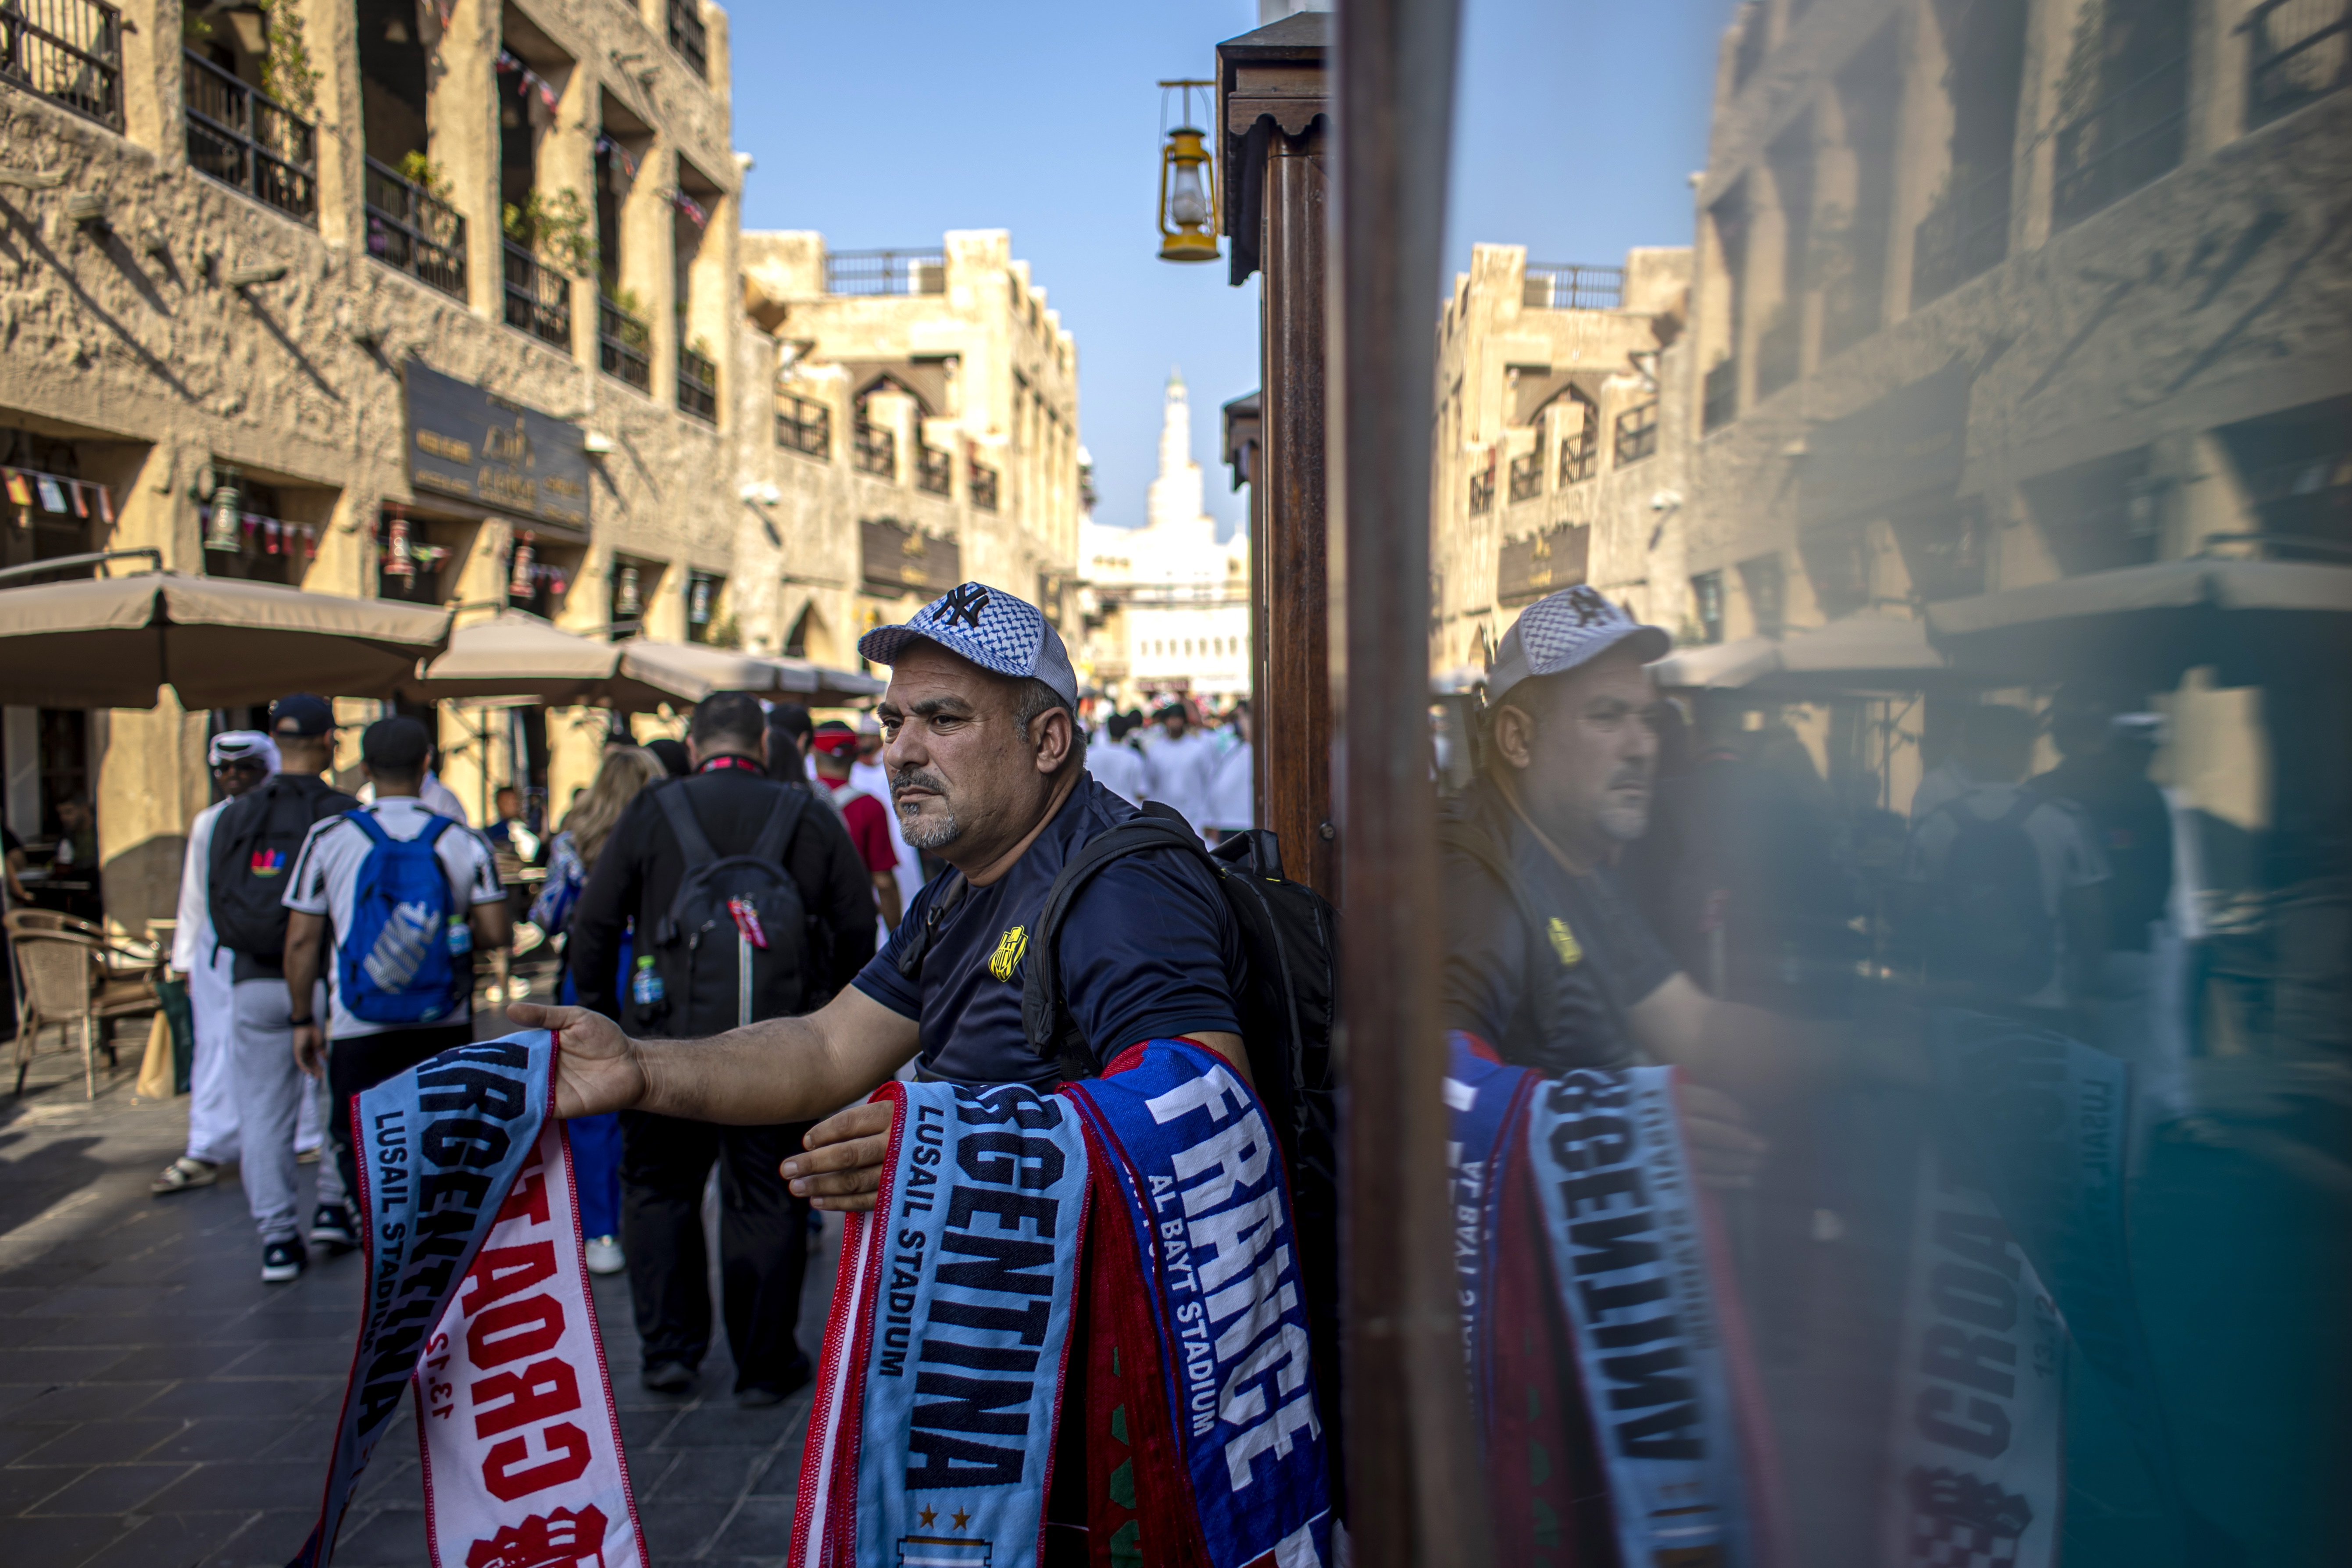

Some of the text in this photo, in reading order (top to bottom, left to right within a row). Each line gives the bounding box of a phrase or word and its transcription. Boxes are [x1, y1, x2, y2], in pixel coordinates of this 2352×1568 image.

[933, 583, 990, 628] NY
[363, 900, 439, 995] NIKE
[362, 1110, 408, 1355] LUSAIL STADIUM
[879, 1105, 944, 1377] LUSAIL STADIUM
[1144, 1063, 1321, 1492] FRANCE
[1148, 1175, 1219, 1437] AL BAYT STADIUM
